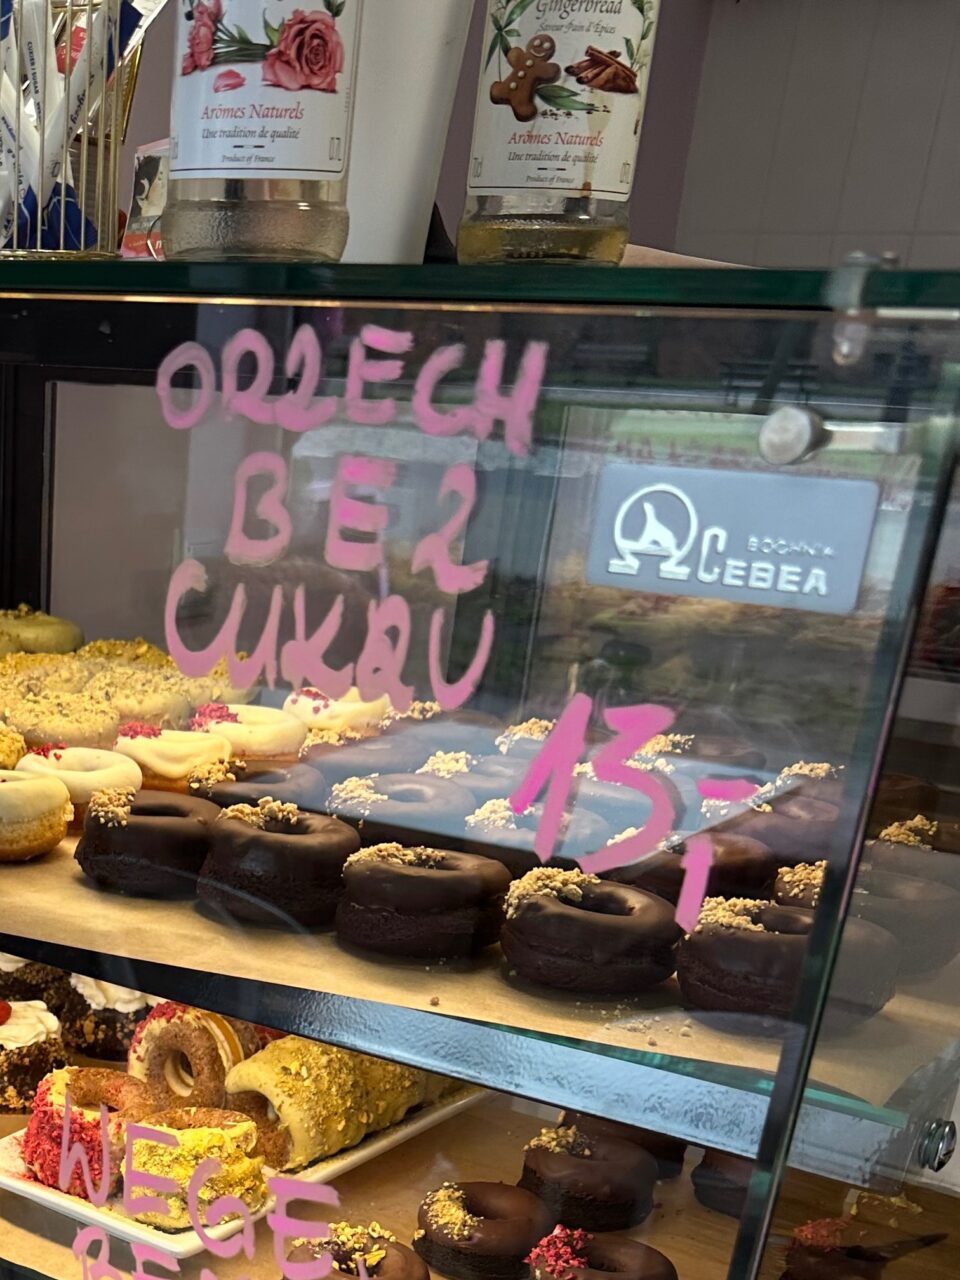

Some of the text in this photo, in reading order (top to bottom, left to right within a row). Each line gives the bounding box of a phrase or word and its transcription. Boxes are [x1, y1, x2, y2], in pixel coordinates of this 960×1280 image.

[201, 101, 305, 120] Arômes Naturels
[218, 126, 257, 139] tradition
[258, 126, 269, 138] de
[269, 126, 302, 143] qualité
[507, 130, 604, 147] Arômes Naturels
[525, 150, 560, 163] tradition
[561, 151, 571, 162] de
[156, 323, 551, 457] ORZECH
[696, 525, 829, 597] CEBEA
[165, 559, 496, 711] CUKRU
